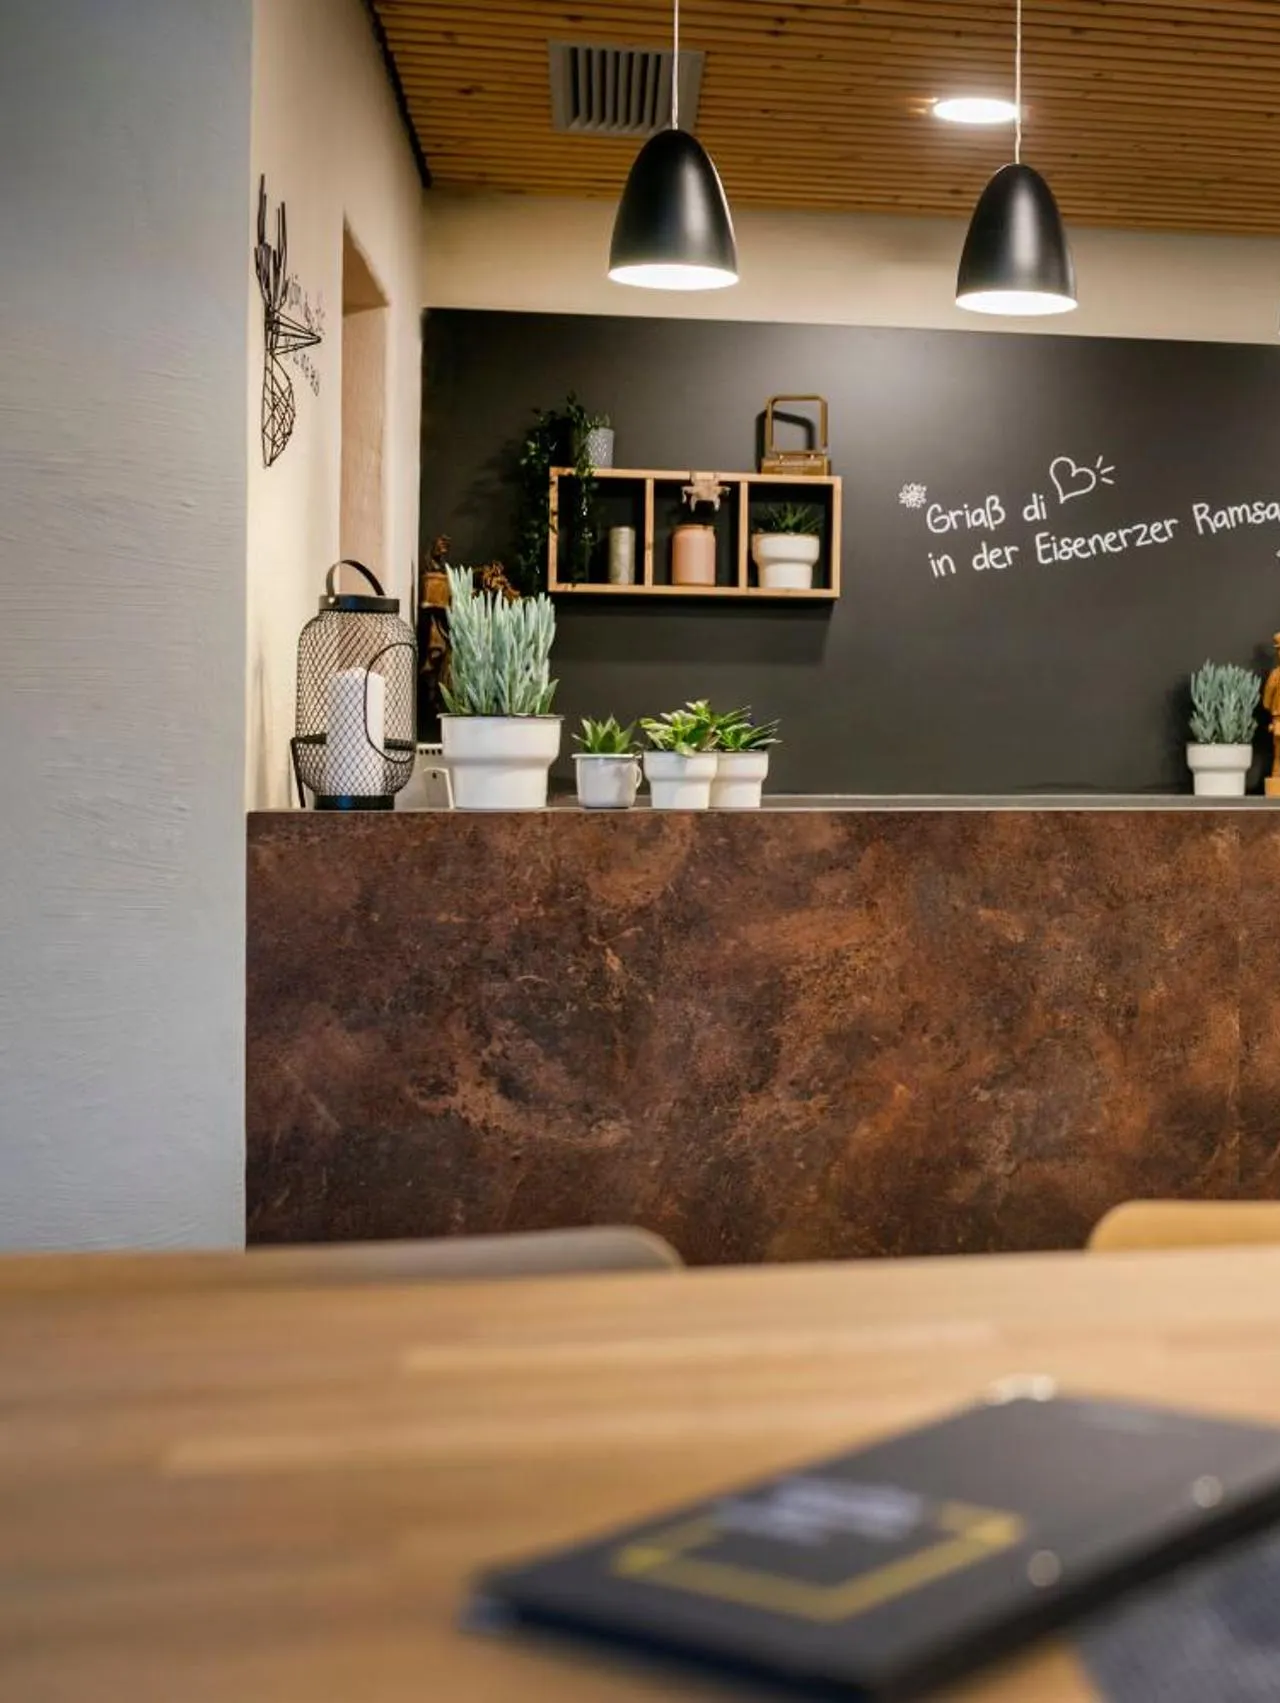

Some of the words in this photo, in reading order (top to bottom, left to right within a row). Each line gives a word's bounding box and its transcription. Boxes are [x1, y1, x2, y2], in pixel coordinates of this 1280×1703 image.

[926, 495, 1007, 534] Griaß
[1022, 492, 1048, 523] di
[928, 552, 957, 579] in
[972, 541, 1020, 572] der
[1035, 517, 1180, 566] Eisenerzer
